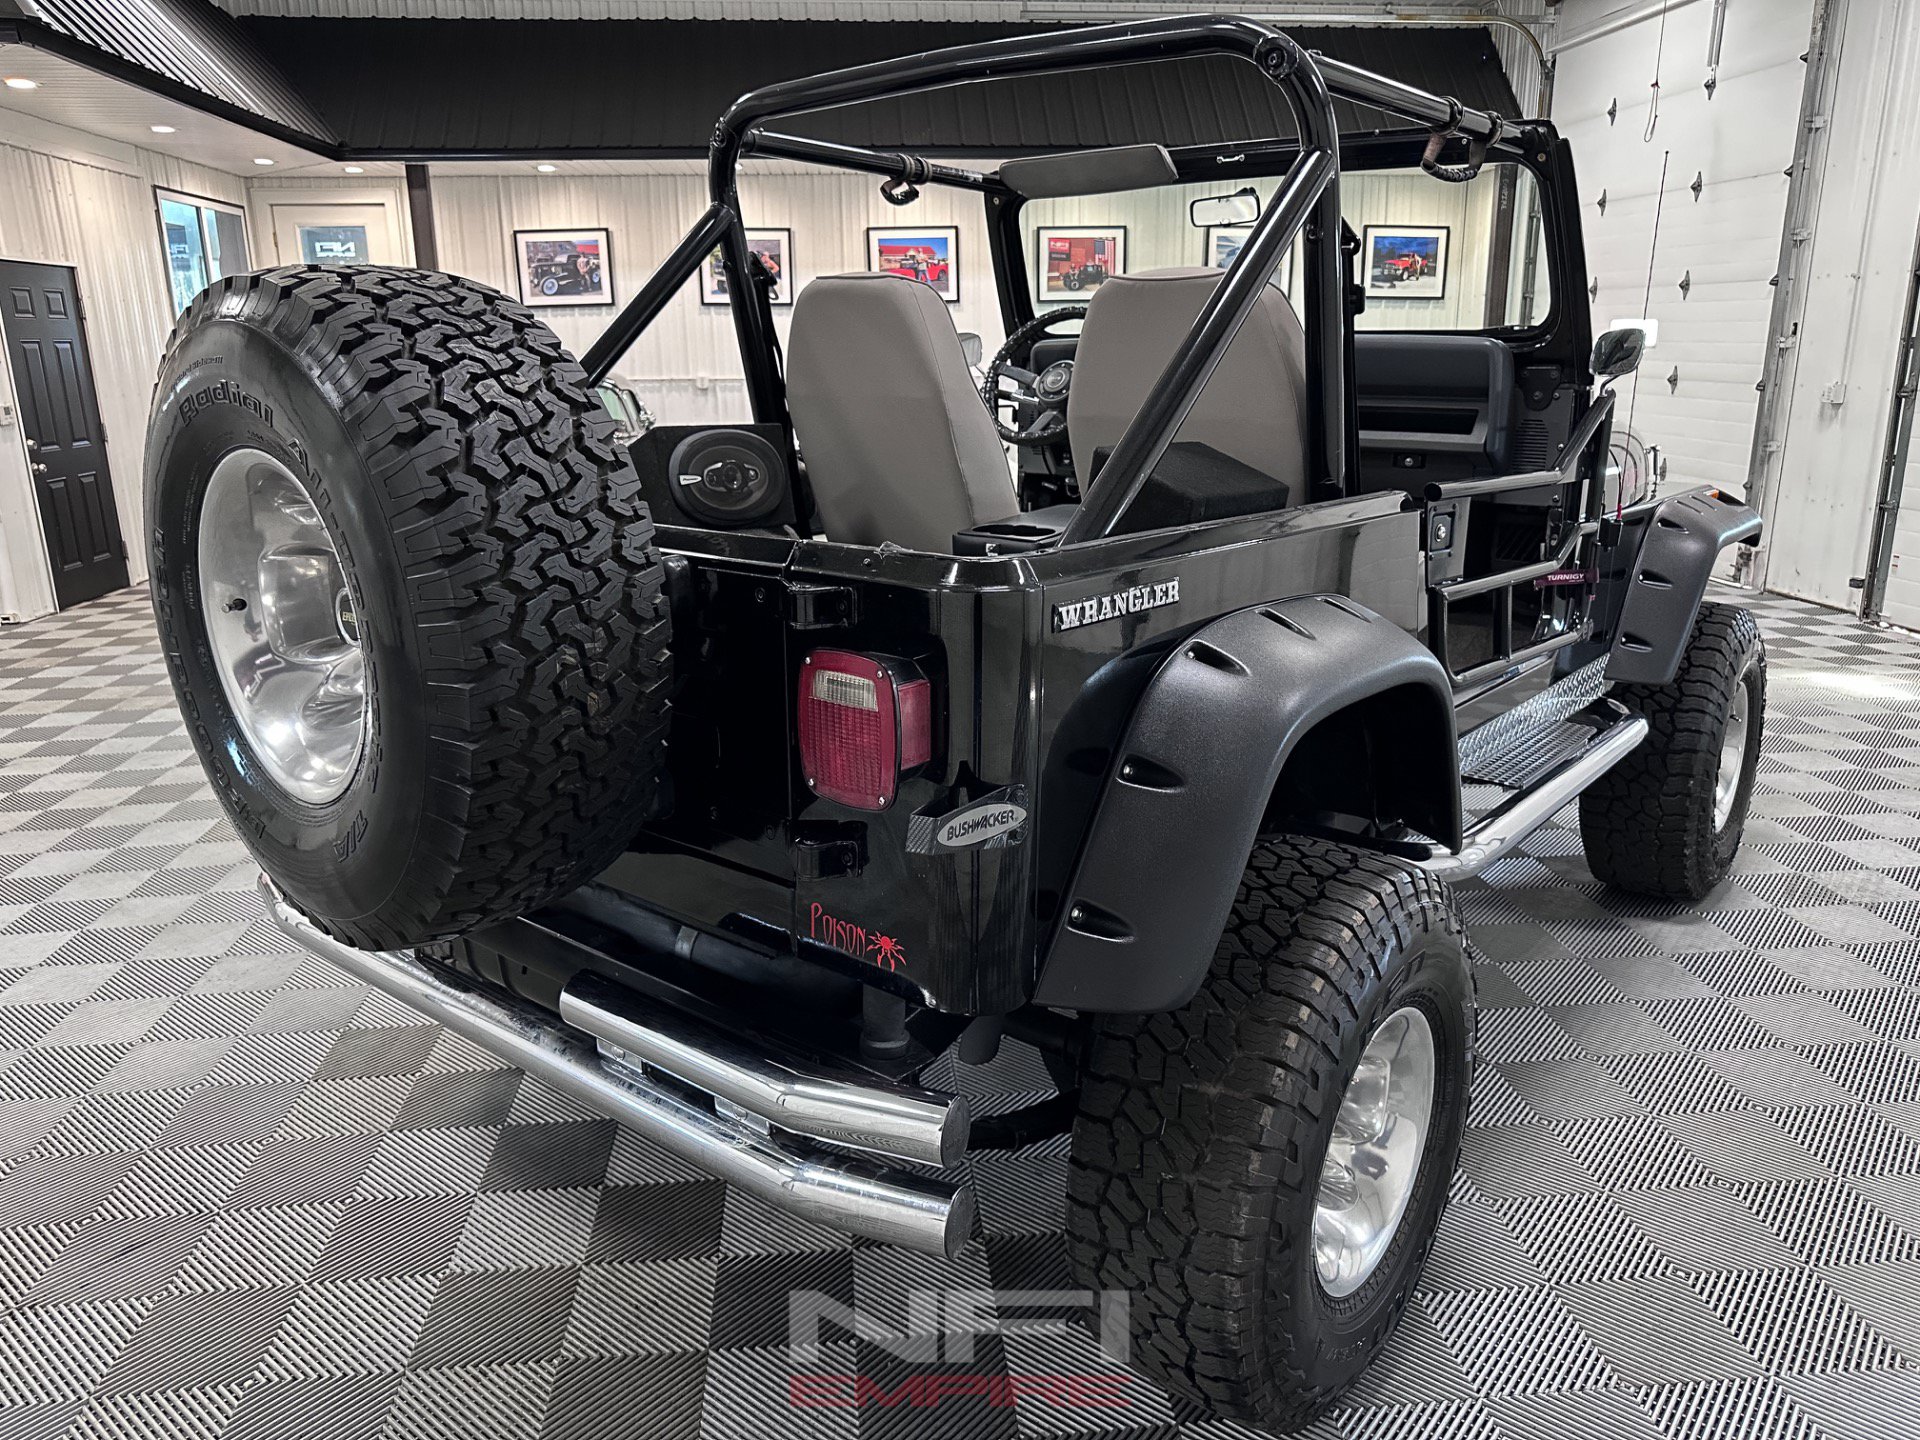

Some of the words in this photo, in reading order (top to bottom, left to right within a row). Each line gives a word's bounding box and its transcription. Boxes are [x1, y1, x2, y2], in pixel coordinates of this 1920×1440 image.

[1547, 573, 1585, 581] TURNIGY
[179, 379, 274, 429] Radial
[332, 809, 369, 864] T/A
[1059, 579, 1180, 631] WRANGLER
[946, 809, 1015, 841] BUSHWACKER
